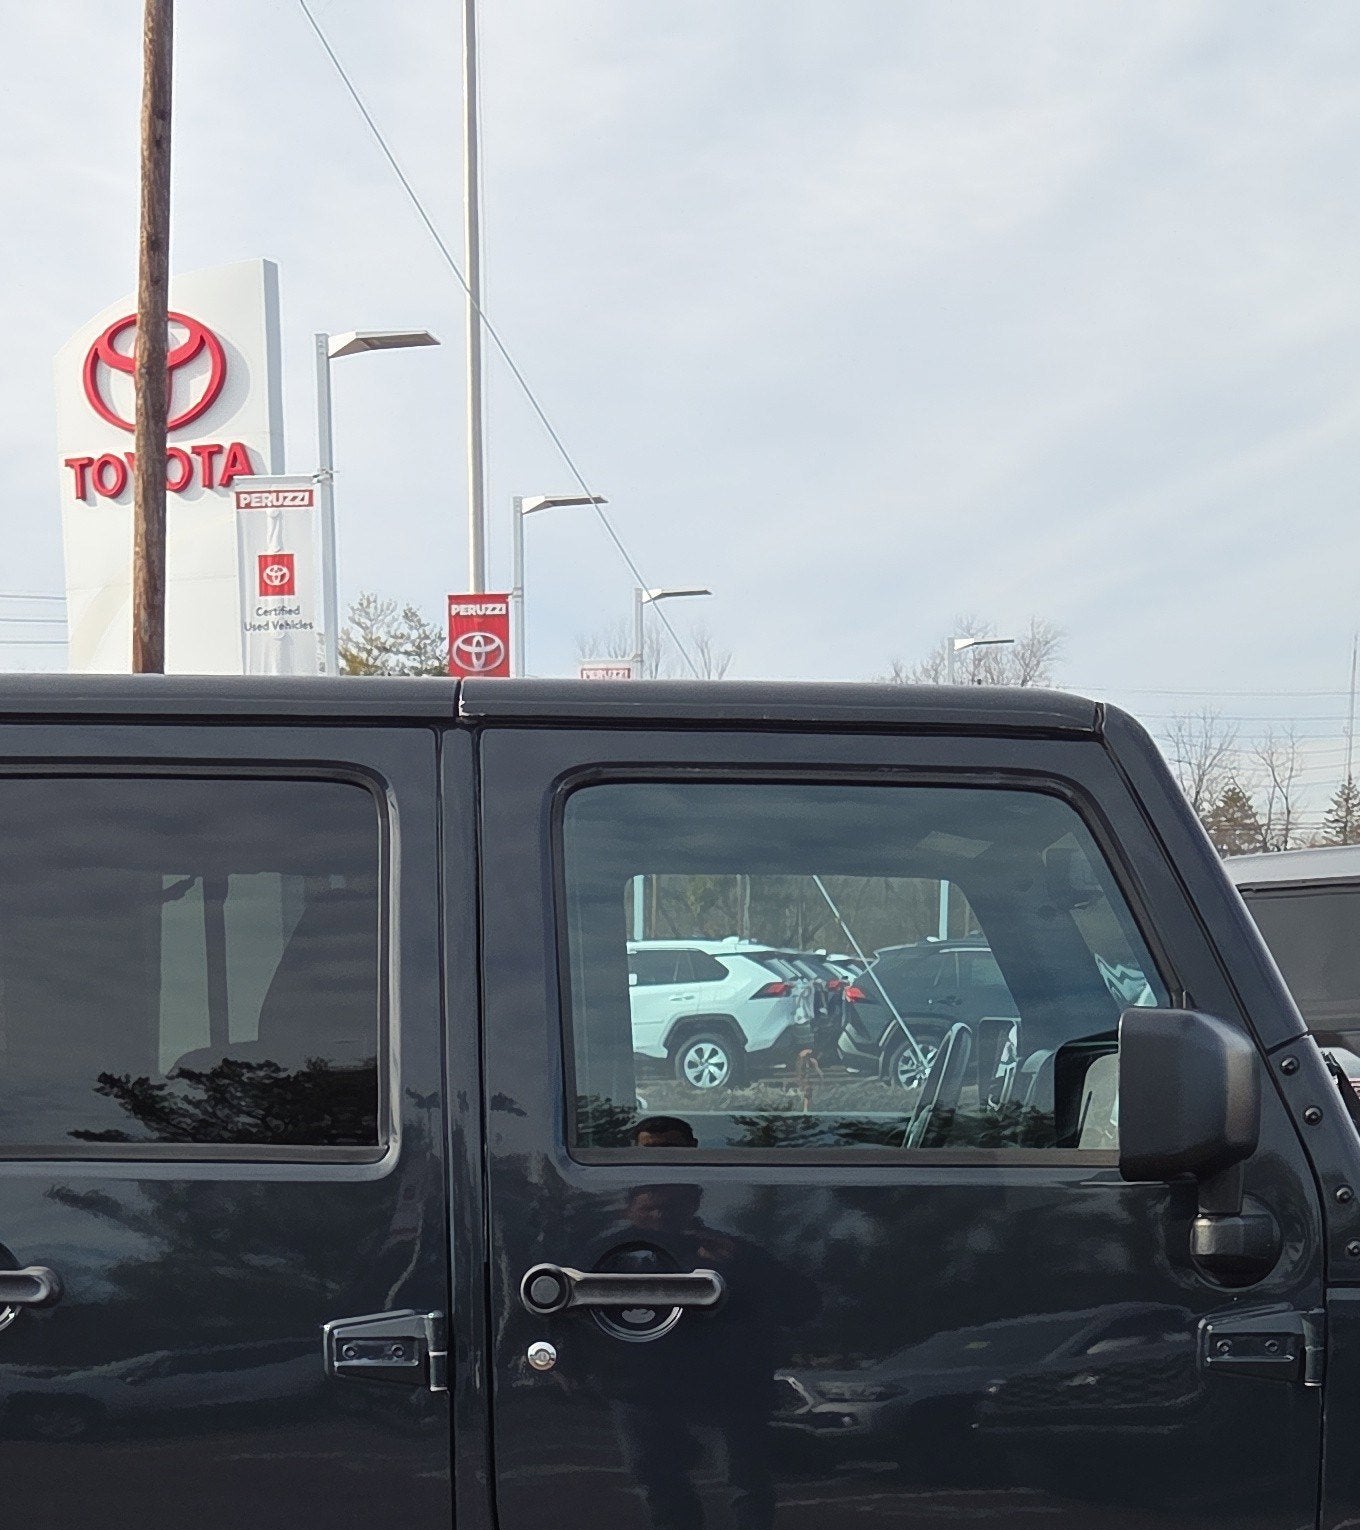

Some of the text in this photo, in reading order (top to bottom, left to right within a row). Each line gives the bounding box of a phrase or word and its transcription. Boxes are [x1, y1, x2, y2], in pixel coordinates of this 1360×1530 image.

[65, 442, 255, 501] TOOTA
[239, 491, 310, 508] PERUZZI
[255, 605, 300, 617] Certified
[451, 603, 507, 616] PERUZZI
[272, 619, 314, 631] Vehicles
